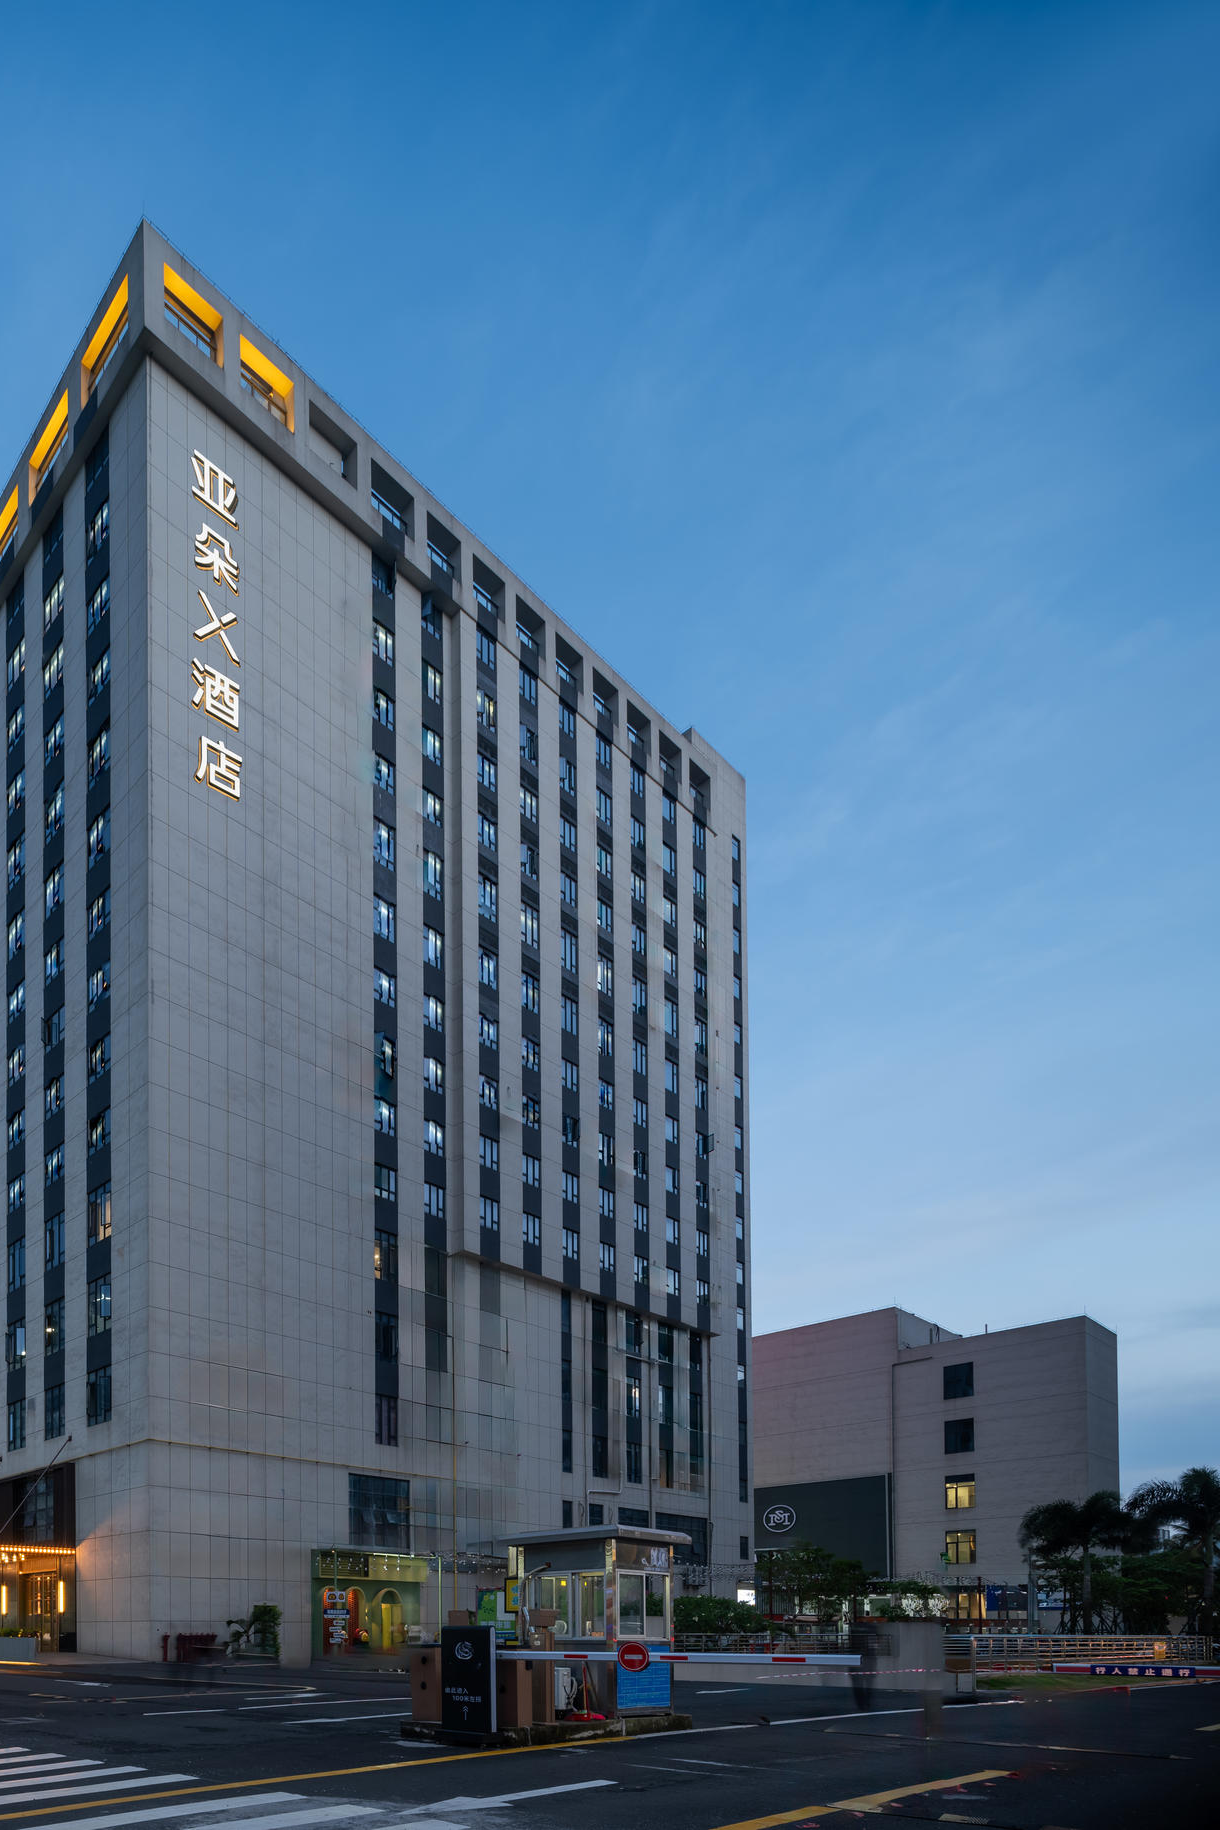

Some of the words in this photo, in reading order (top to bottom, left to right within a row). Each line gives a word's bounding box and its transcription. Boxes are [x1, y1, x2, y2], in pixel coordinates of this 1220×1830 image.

[191, 449, 243, 800] 亚朵X酒店
[1095, 1667, 1190, 1677] 行人禁止通行
